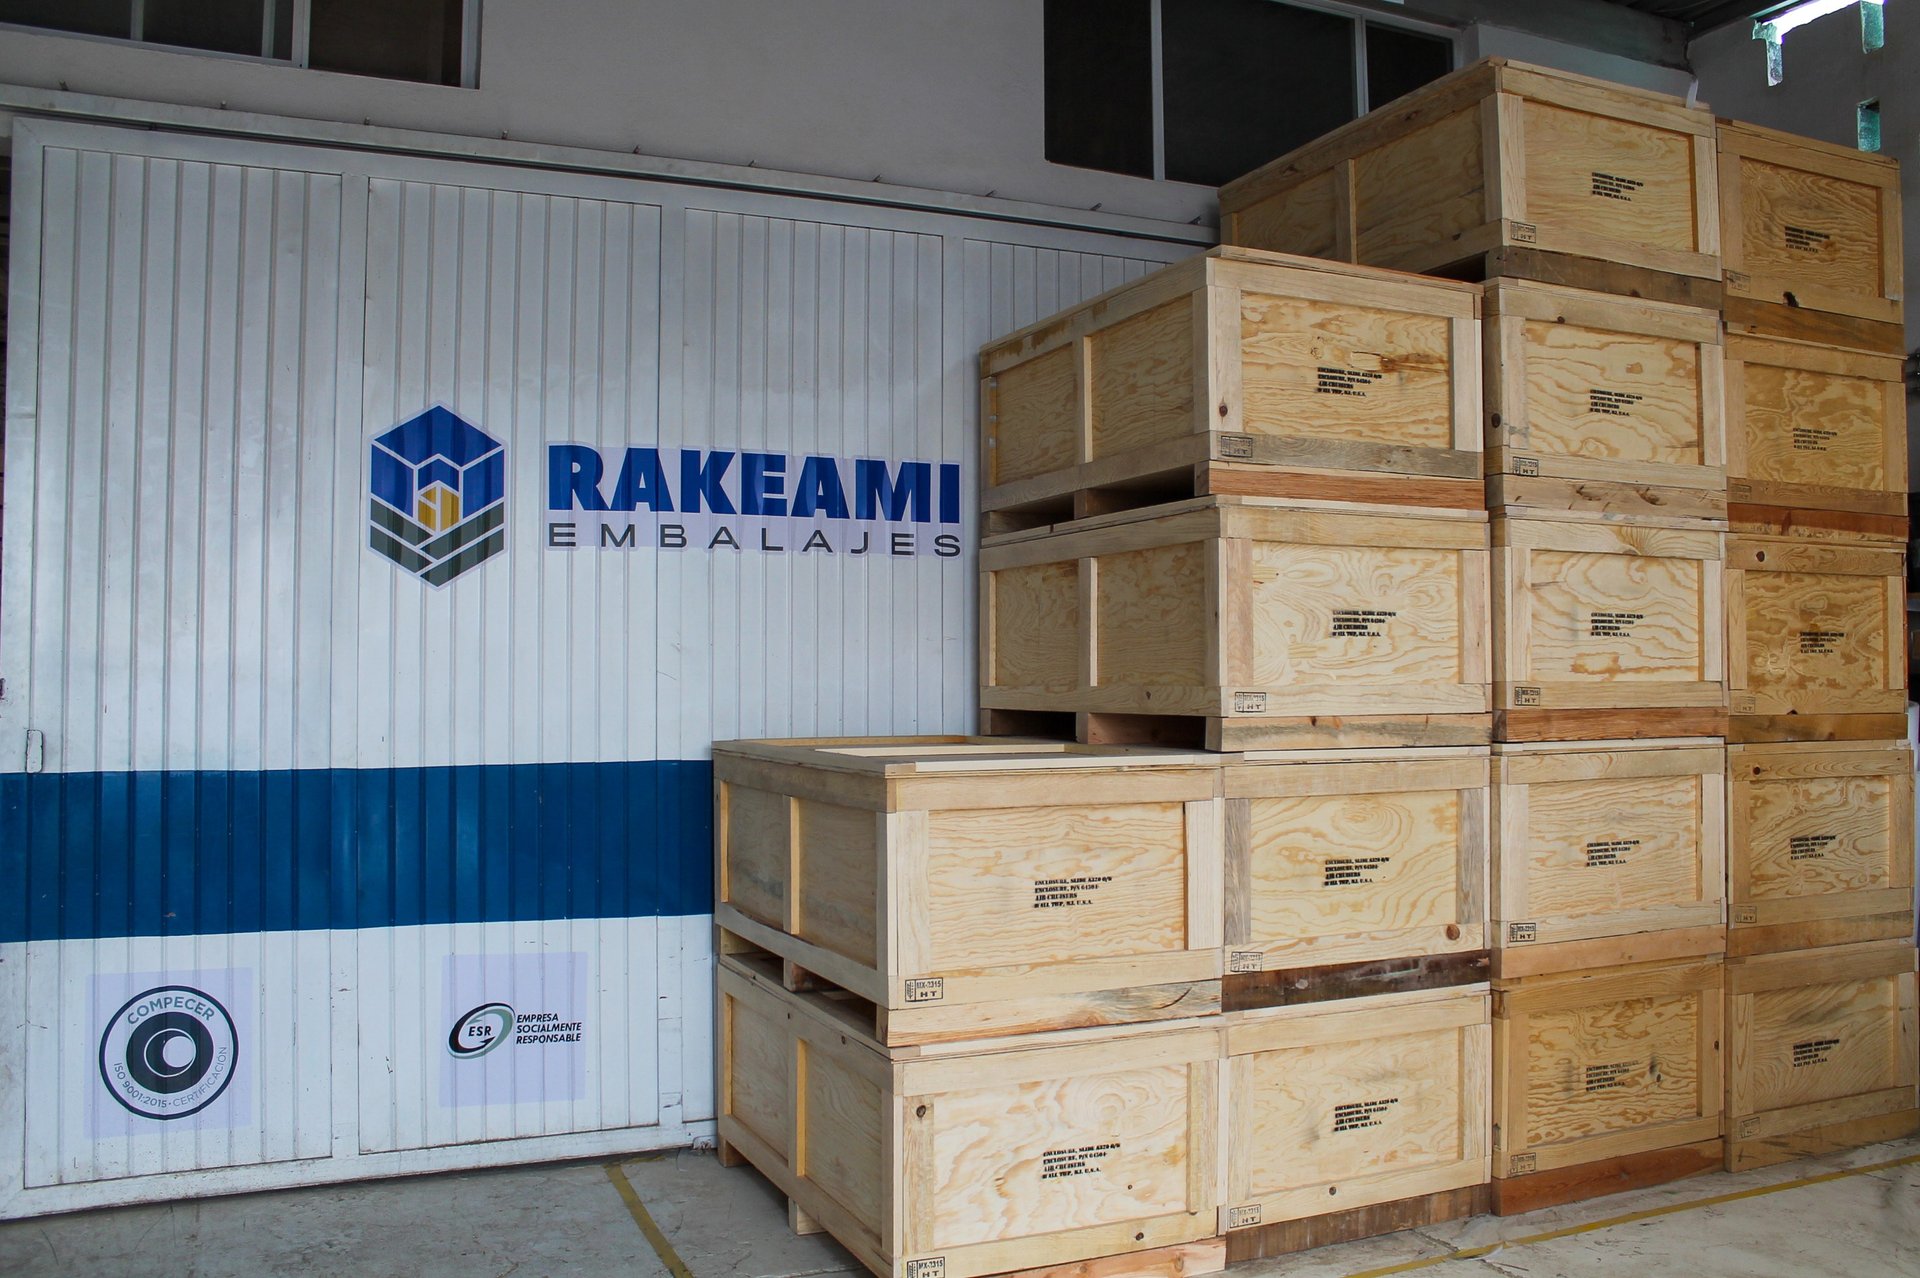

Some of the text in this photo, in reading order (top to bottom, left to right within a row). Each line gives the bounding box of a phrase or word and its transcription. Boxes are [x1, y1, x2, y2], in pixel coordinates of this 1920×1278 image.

[548, 444, 961, 524] RAKEAMI
[549, 523, 961, 557] EMBALAJES
[1035, 886, 1069, 894] ENCLOSURE,
[128, 996, 215, 1025] COMPECER
[516, 1013, 559, 1023] EMPRESA
[468, 1025, 492, 1037] ESR
[516, 1022, 582, 1034] SOCIALMENTE
[516, 1033, 582, 1045] RESPONSABLE
[114, 1062, 125, 1079] ISO
[122, 1081, 167, 1108] 9001:2015
[1043, 1155, 1077, 1165] ENCLOSURE,
[1055, 1161, 1085, 1170] CRUISERS
